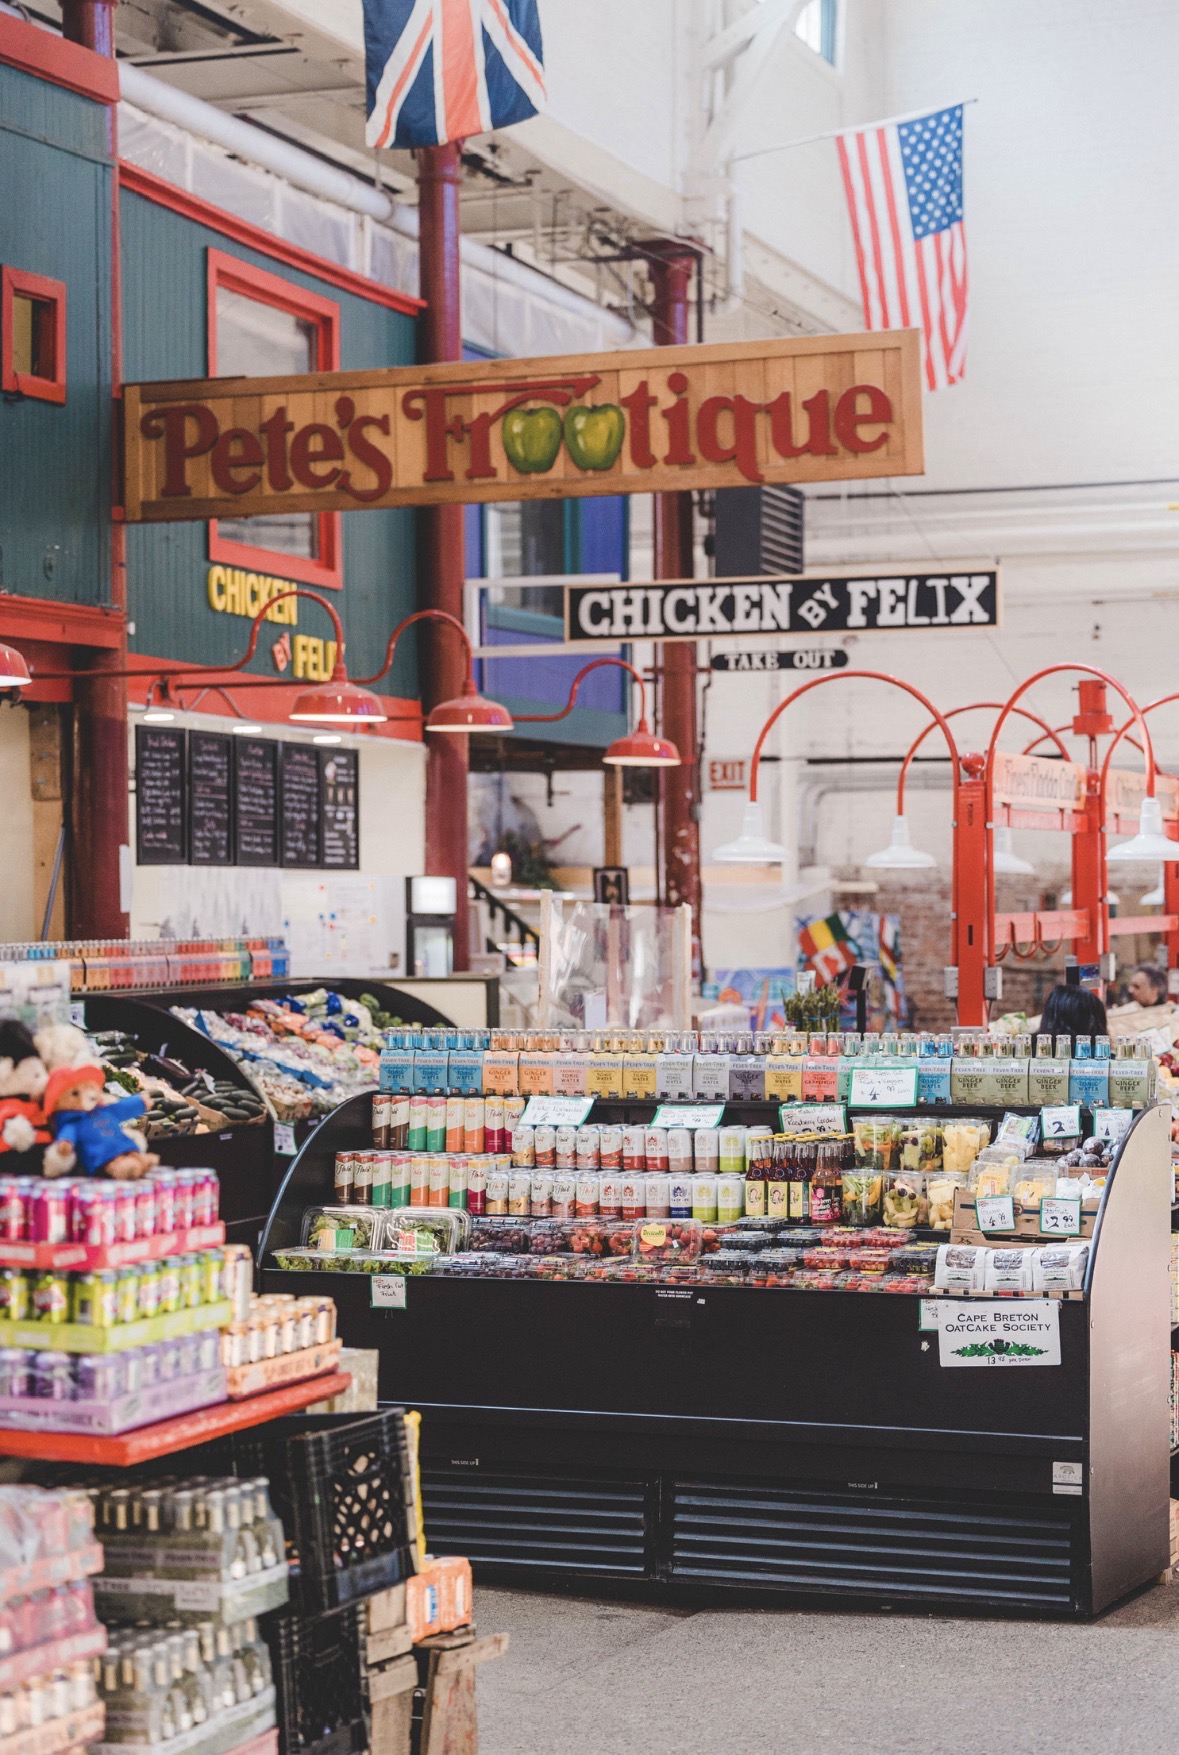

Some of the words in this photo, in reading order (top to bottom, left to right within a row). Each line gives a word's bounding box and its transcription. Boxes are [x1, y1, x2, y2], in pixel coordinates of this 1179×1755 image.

[208, 565, 298, 626] CHICKEN
[579, 585, 793, 636] CHICKEN
[798, 583, 838, 629] BY
[846, 576, 990, 628] FELIX
[724, 652, 779, 671] TAKE
[794, 650, 835, 669] OUT
[710, 762, 744, 781] EXIT
